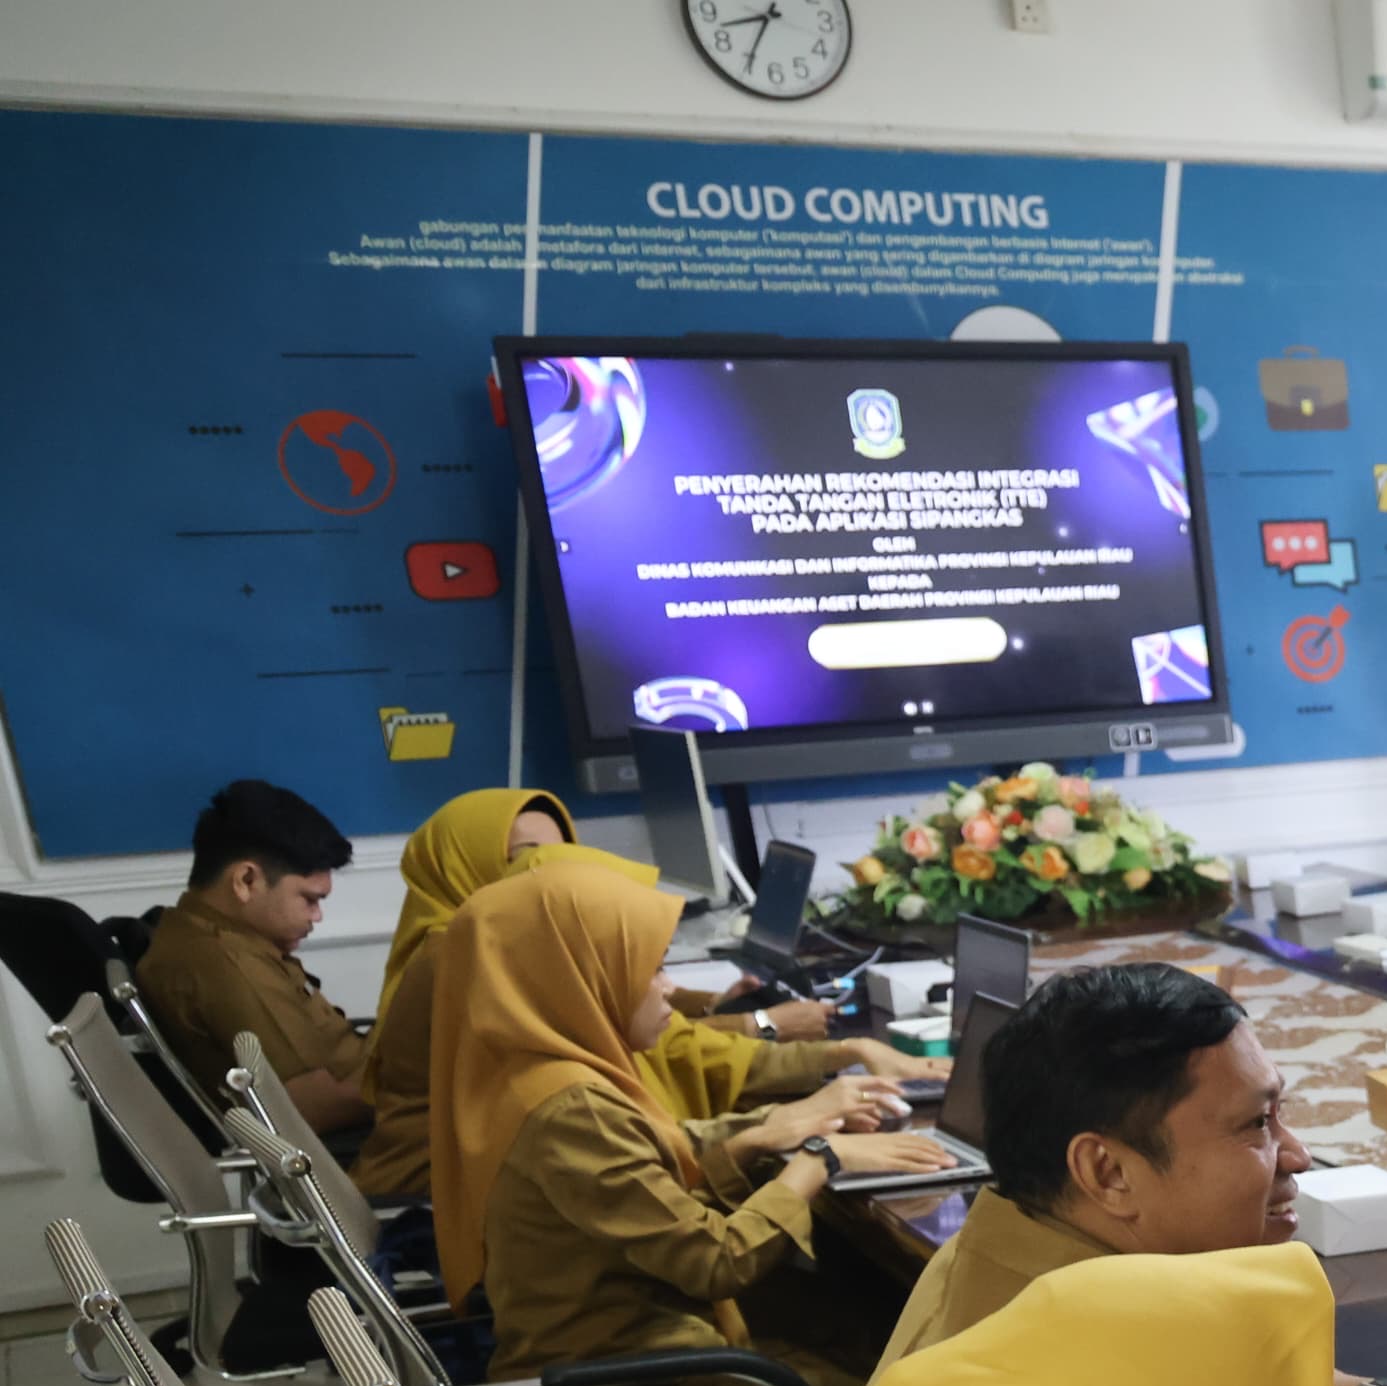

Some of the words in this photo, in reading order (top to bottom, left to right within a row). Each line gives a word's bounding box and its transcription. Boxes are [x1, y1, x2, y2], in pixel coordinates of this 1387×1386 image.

[700, 0, 717, 23] 9
[817, 10, 833, 33] 3
[714, 30, 732, 52] 8
[811, 38, 828, 60] 4
[767, 62, 785, 85] 6
[792, 56, 809, 80] 5
[646, 181, 796, 222] CLOUD
[804, 186, 1050, 229] COMPUTING
[419, 220, 499, 237] gabungan
[616, 225, 685, 242] teknologi
[688, 226, 758, 242] komputer
[856, 231, 881, 246] dan
[885, 232, 989, 249] pengembangan
[991, 235, 1049, 249] berbasis
[361, 233, 406, 249] Awan
[410, 236, 467, 253] (cloud)
[470, 238, 523, 251] adalah
[608, 241, 638, 255] dari
[705, 246, 801, 261] sebagaimana
[804, 248, 841, 260] awan
[844, 250, 880, 263] yang
[882, 250, 926, 265] sering
[1017, 251, 1030, 265] di
[328, 251, 440, 270] Sebagaimana
[443, 256, 486, 268] awan
[550, 256, 614, 274] diagram
[616, 258, 678, 275] jaringan
[680, 260, 751, 276] komputer
[820, 264, 857, 276] awan
[954, 265, 995, 280] Cloud
[997, 266, 1069, 283] Computing
[635, 275, 666, 290] dari
[667, 276, 759, 292] infrastruktur
[673, 473, 822, 495] PENYERAHAN
[825, 470, 976, 493] REKOMENDASI
[977, 467, 1081, 490] INTEGRASI
[716, 493, 796, 515] TANDA
[797, 491, 882, 513] TANGAN
[886, 489, 997, 511] ELETRONIK
[999, 487, 1049, 510] (TTE)
[750, 513, 815, 534] PADA
[815, 511, 907, 532] APLIKASI
[909, 508, 1024, 530] SIPANGKAS
[872, 536, 917, 553] OLEH
[636, 562, 691, 580] DINAS
[691, 559, 794, 578] KOMUNIKASI
[794, 557, 832, 574] DAN
[832, 554, 938, 573] INFORMATIKA
[1009, 549, 1098, 568] KEPULAUAN
[1098, 547, 1134, 564] RIAU
[867, 573, 934, 591] KEPADA
[665, 600, 727, 618] BADAN
[727, 597, 817, 616] KEUANGAN
[996, 586, 1084, 605] KEPULAUAN
[1084, 584, 1121, 601] RIAU
